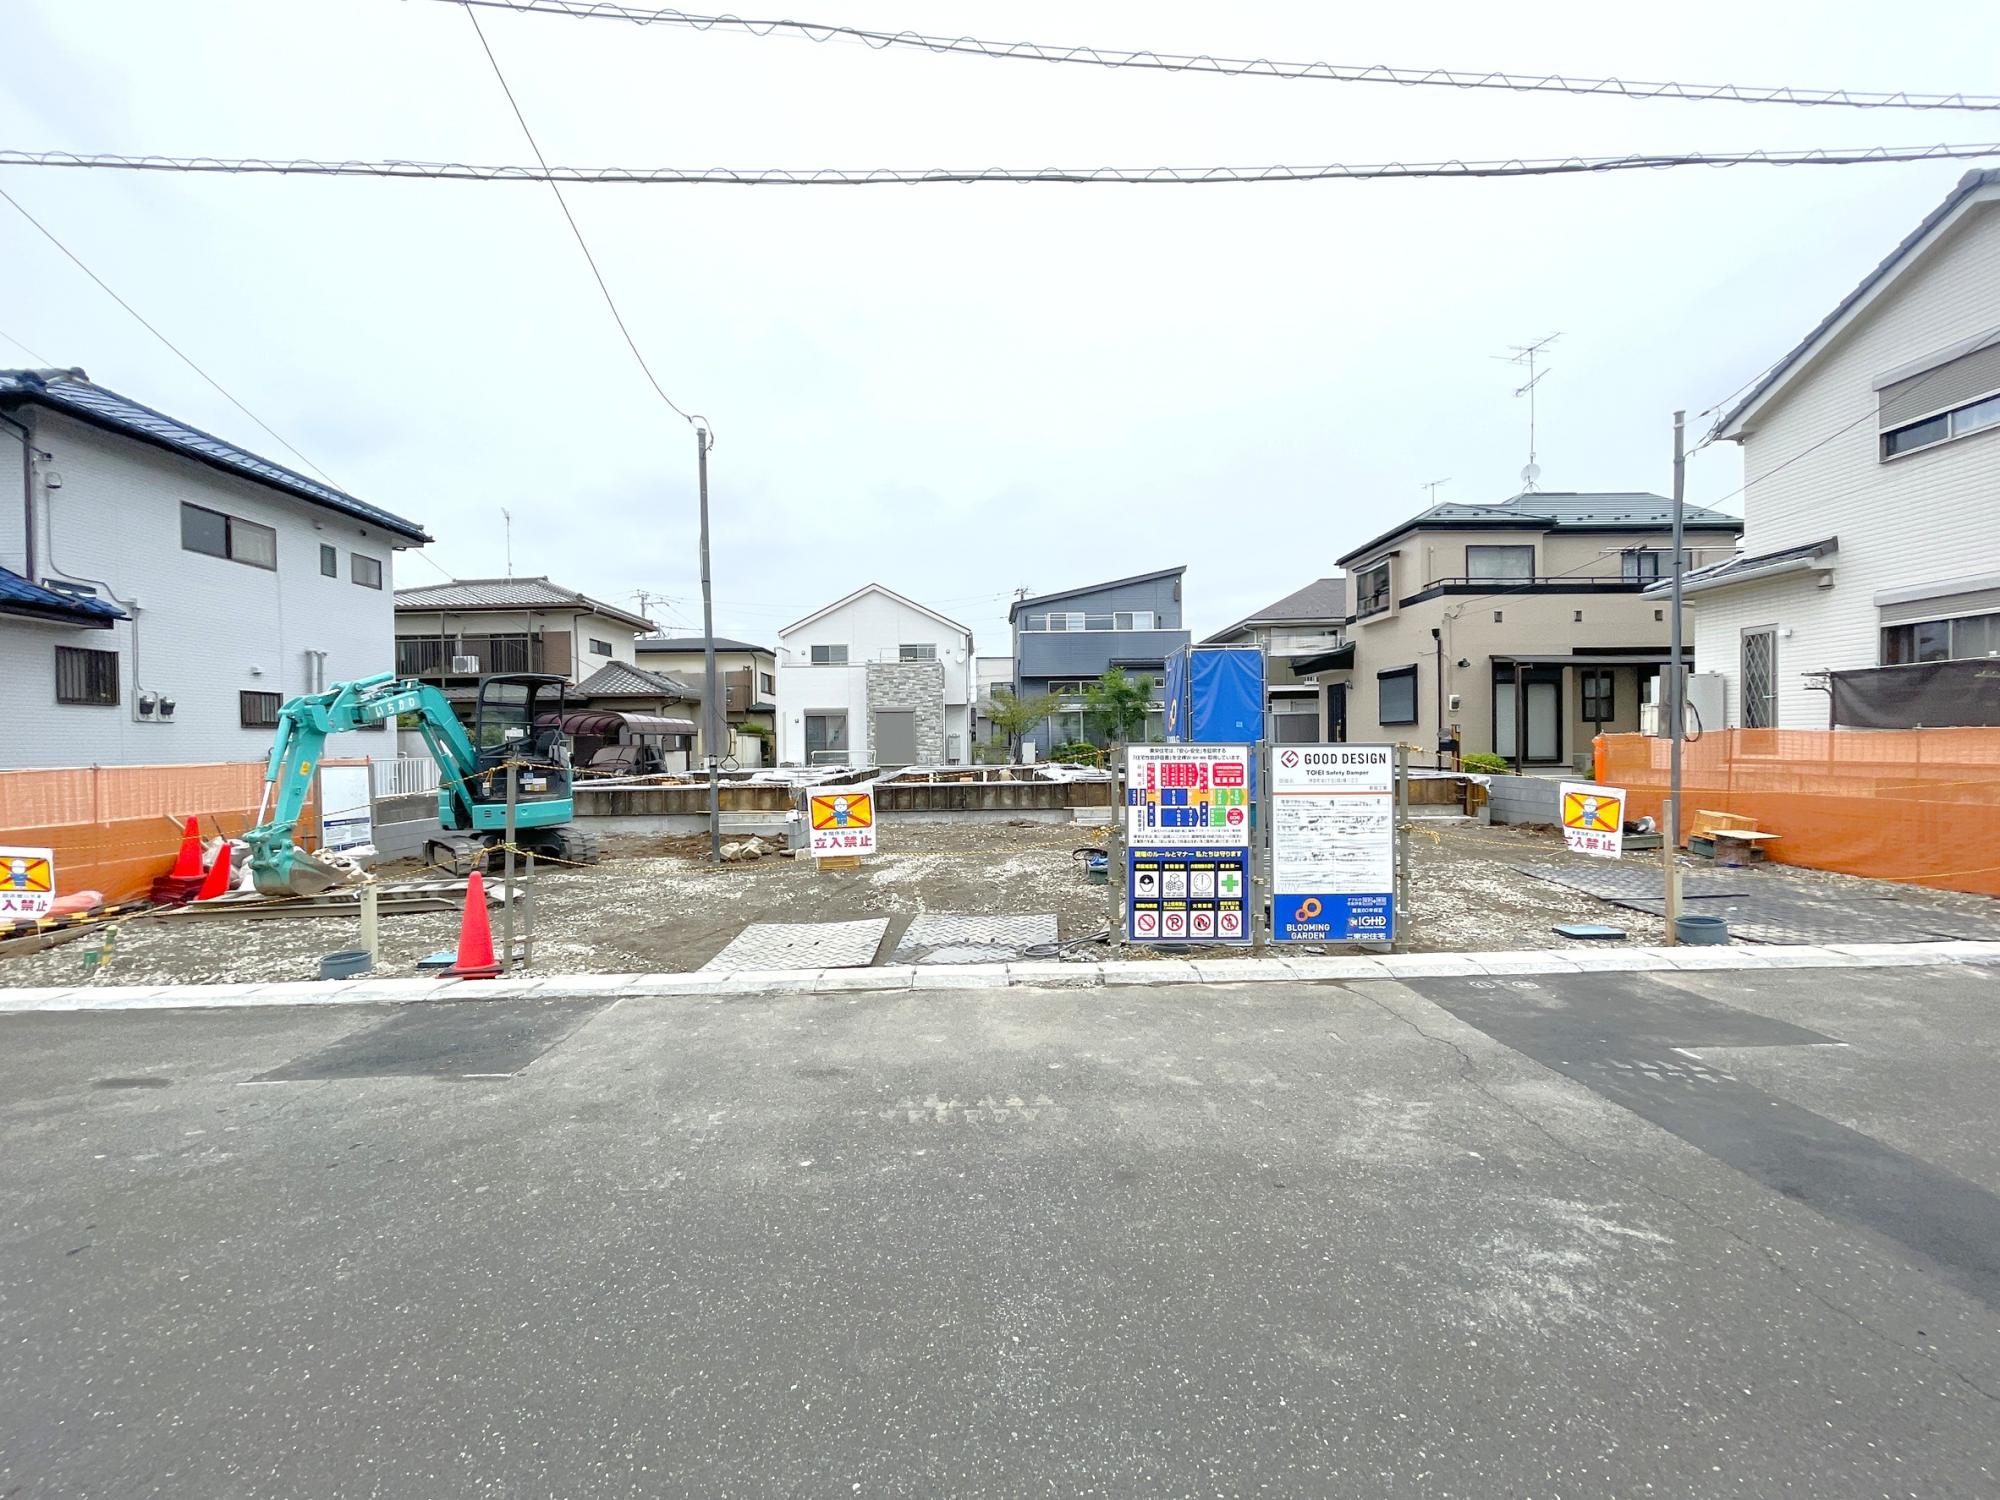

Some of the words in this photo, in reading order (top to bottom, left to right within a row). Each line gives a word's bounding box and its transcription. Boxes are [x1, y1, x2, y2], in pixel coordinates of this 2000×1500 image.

[1304, 753, 1338, 765] GOOD
[1342, 753, 1386, 765] DESIGN
[814, 835, 873, 849] 立入禁止
[2, 899, 48, 912] 入禁止
[1358, 916, 1387, 926] IGHD
[1286, 924, 1330, 932] BLOOMING
[1291, 932, 1325, 940] GARDEN
